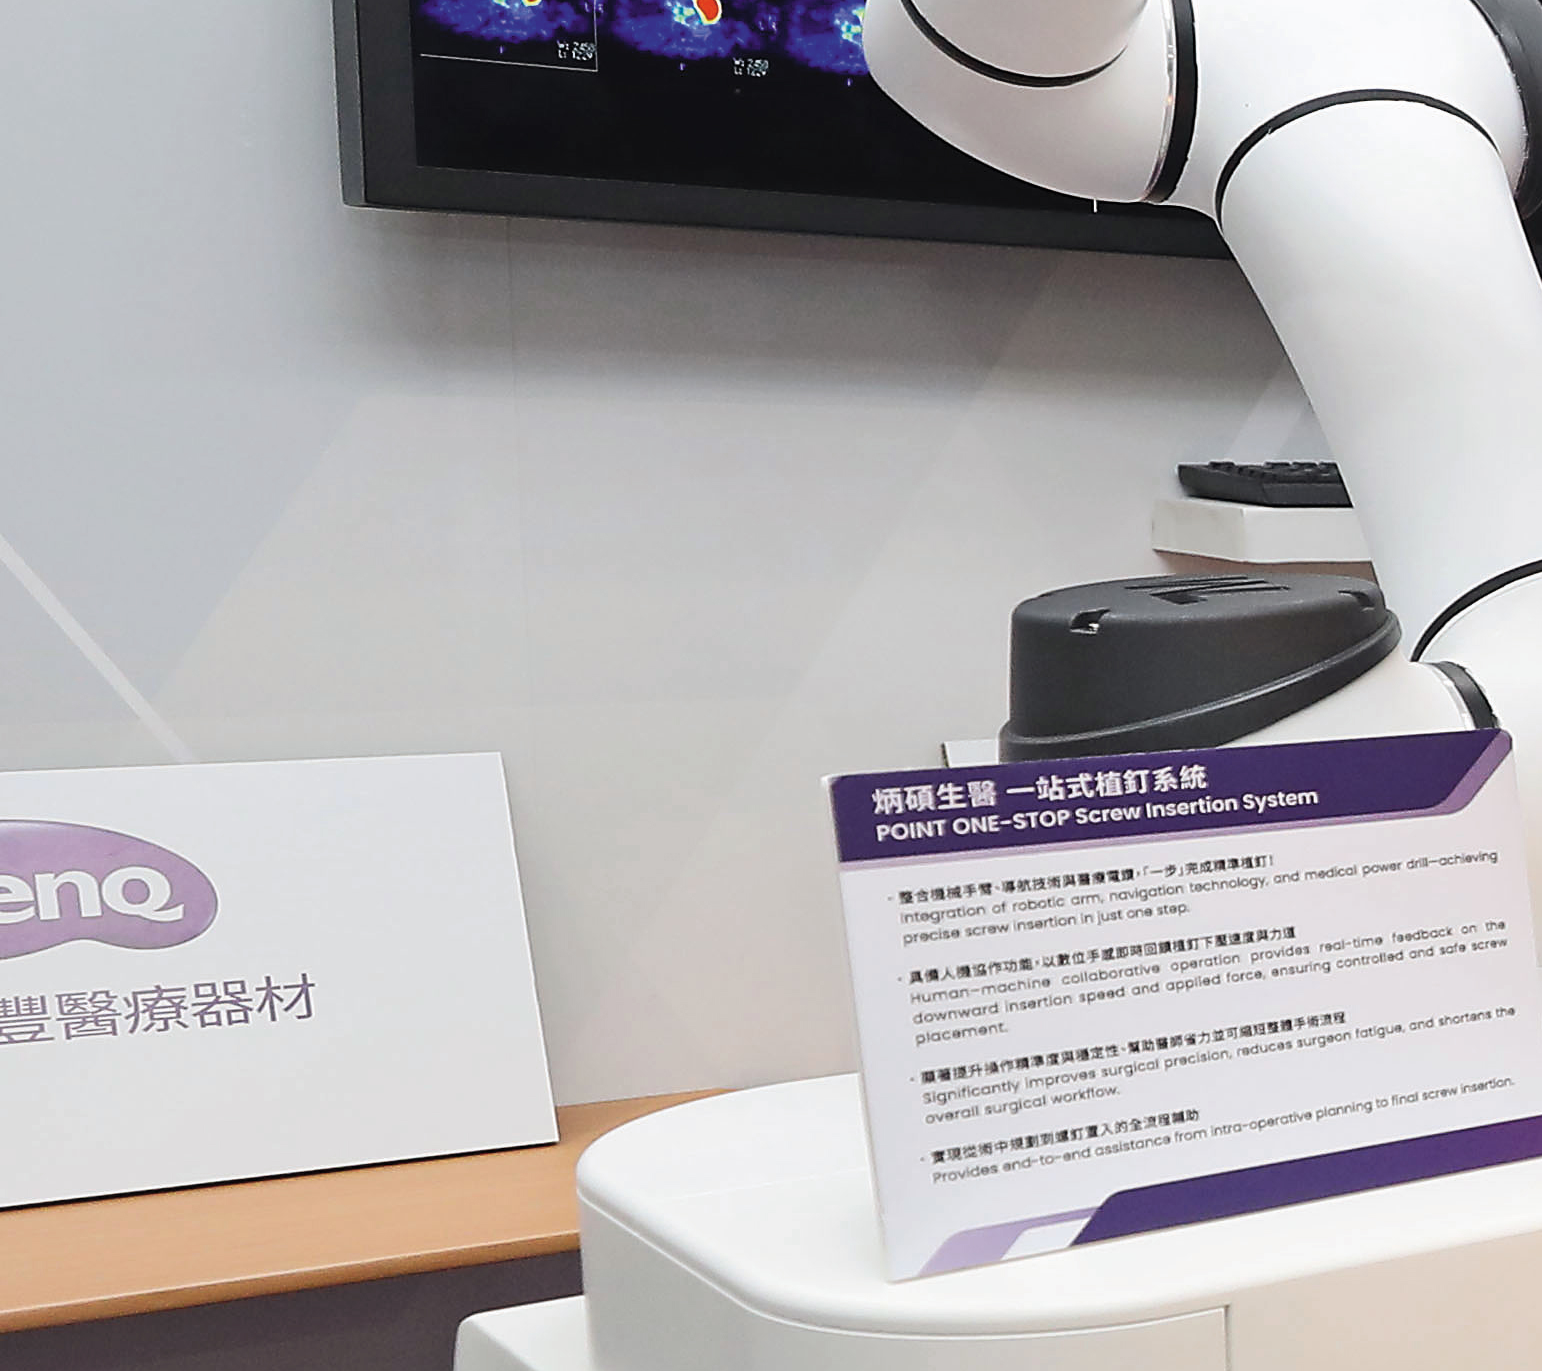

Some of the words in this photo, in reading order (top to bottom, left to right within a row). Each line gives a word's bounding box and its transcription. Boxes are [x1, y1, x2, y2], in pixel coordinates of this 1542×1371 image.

[872, 780, 997, 815] 炳碩生醫
[1006, 764, 1208, 802] 一站式植釘系統
[876, 820, 947, 842] POINT
[953, 809, 1070, 836] ONE-STOP
[1075, 805, 1141, 825] Screw
[1146, 797, 1238, 819] Insertion
[1242, 790, 1319, 814] System
[992, 901, 1007, 915] of
[1012, 895, 1066, 912] robotic
[1071, 893, 1105, 908] arm,
[1109, 882, 1184, 905] navigation
[1189, 872, 1269, 896] technology,
[1273, 870, 1299, 884] and
[1304, 864, 1357, 881] medical
[1362, 860, 1401, 879] power
[903, 927, 960, 947] precise
[965, 921, 1009, 938] screw
[1013, 913, 1076, 932] insertion
[1080, 911, 1094, 925] in
[1097, 908, 1123, 926] just
[1127, 906, 1153, 920] one
[1156, 901, 1191, 921] step.
[1061, 961, 1161, 986] collaborative
[1170, 952, 1240, 975] operation
[1251, 945, 1311, 965] provides
[1319, 935, 1383, 953] real-time
[1392, 926, 1453, 944] feedback
[1460, 923, 1477, 935] on
[1486, 919, 1506, 931] the
[913, 1002, 999, 1025] downward
[1005, 993, 1072, 1014] insertion
[1079, 987, 1125, 1005] speed
[1132, 981, 1160, 996] and
[1166, 974, 1221, 993] applied
[1226, 968, 1266, 984] force,
[1270, 959, 1331, 978] ensuring
[1336, 949, 1403, 969] controlled
[1408, 946, 1434, 960] and
[1439, 942, 1467, 956] safe
[1471, 939, 1508, 953] screw
[916, 1021, 1009, 1047] placement.
[923, 1079, 1019, 1104] Significantly
[1025, 1067, 1096, 1089] improves
[1101, 1059, 1160, 1078] surgical
[1164, 1049, 1233, 1070] precision,
[1237, 1041, 1293, 1058] reduces
[1297, 1031, 1351, 1049] surgeon
[1355, 1022, 1406, 1041] fatigue,
[1409, 1017, 1435, 1031] and
[1439, 1010, 1492, 1027] shortens
[1495, 1006, 1516, 1018] the
[926, 1105, 979, 1125] overall
[984, 1095, 1046, 1115] surgical
[1051, 1083, 1121, 1104] workflow.
[932, 1162, 998, 1184] Provides
[1003, 1147, 1091, 1172] end-to-end
[1095, 1136, 1171, 1157] assistance
[1175, 1128, 1207, 1144] from
[1211, 1108, 1312, 1138] intra-operative
[1316, 1099, 1373, 1121] planning
[1376, 1096, 1389, 1108] to
[1391, 1091, 1419, 1106] final
[1422, 1086, 1457, 1101] screw
[1460, 1077, 1515, 1095] insertion.
